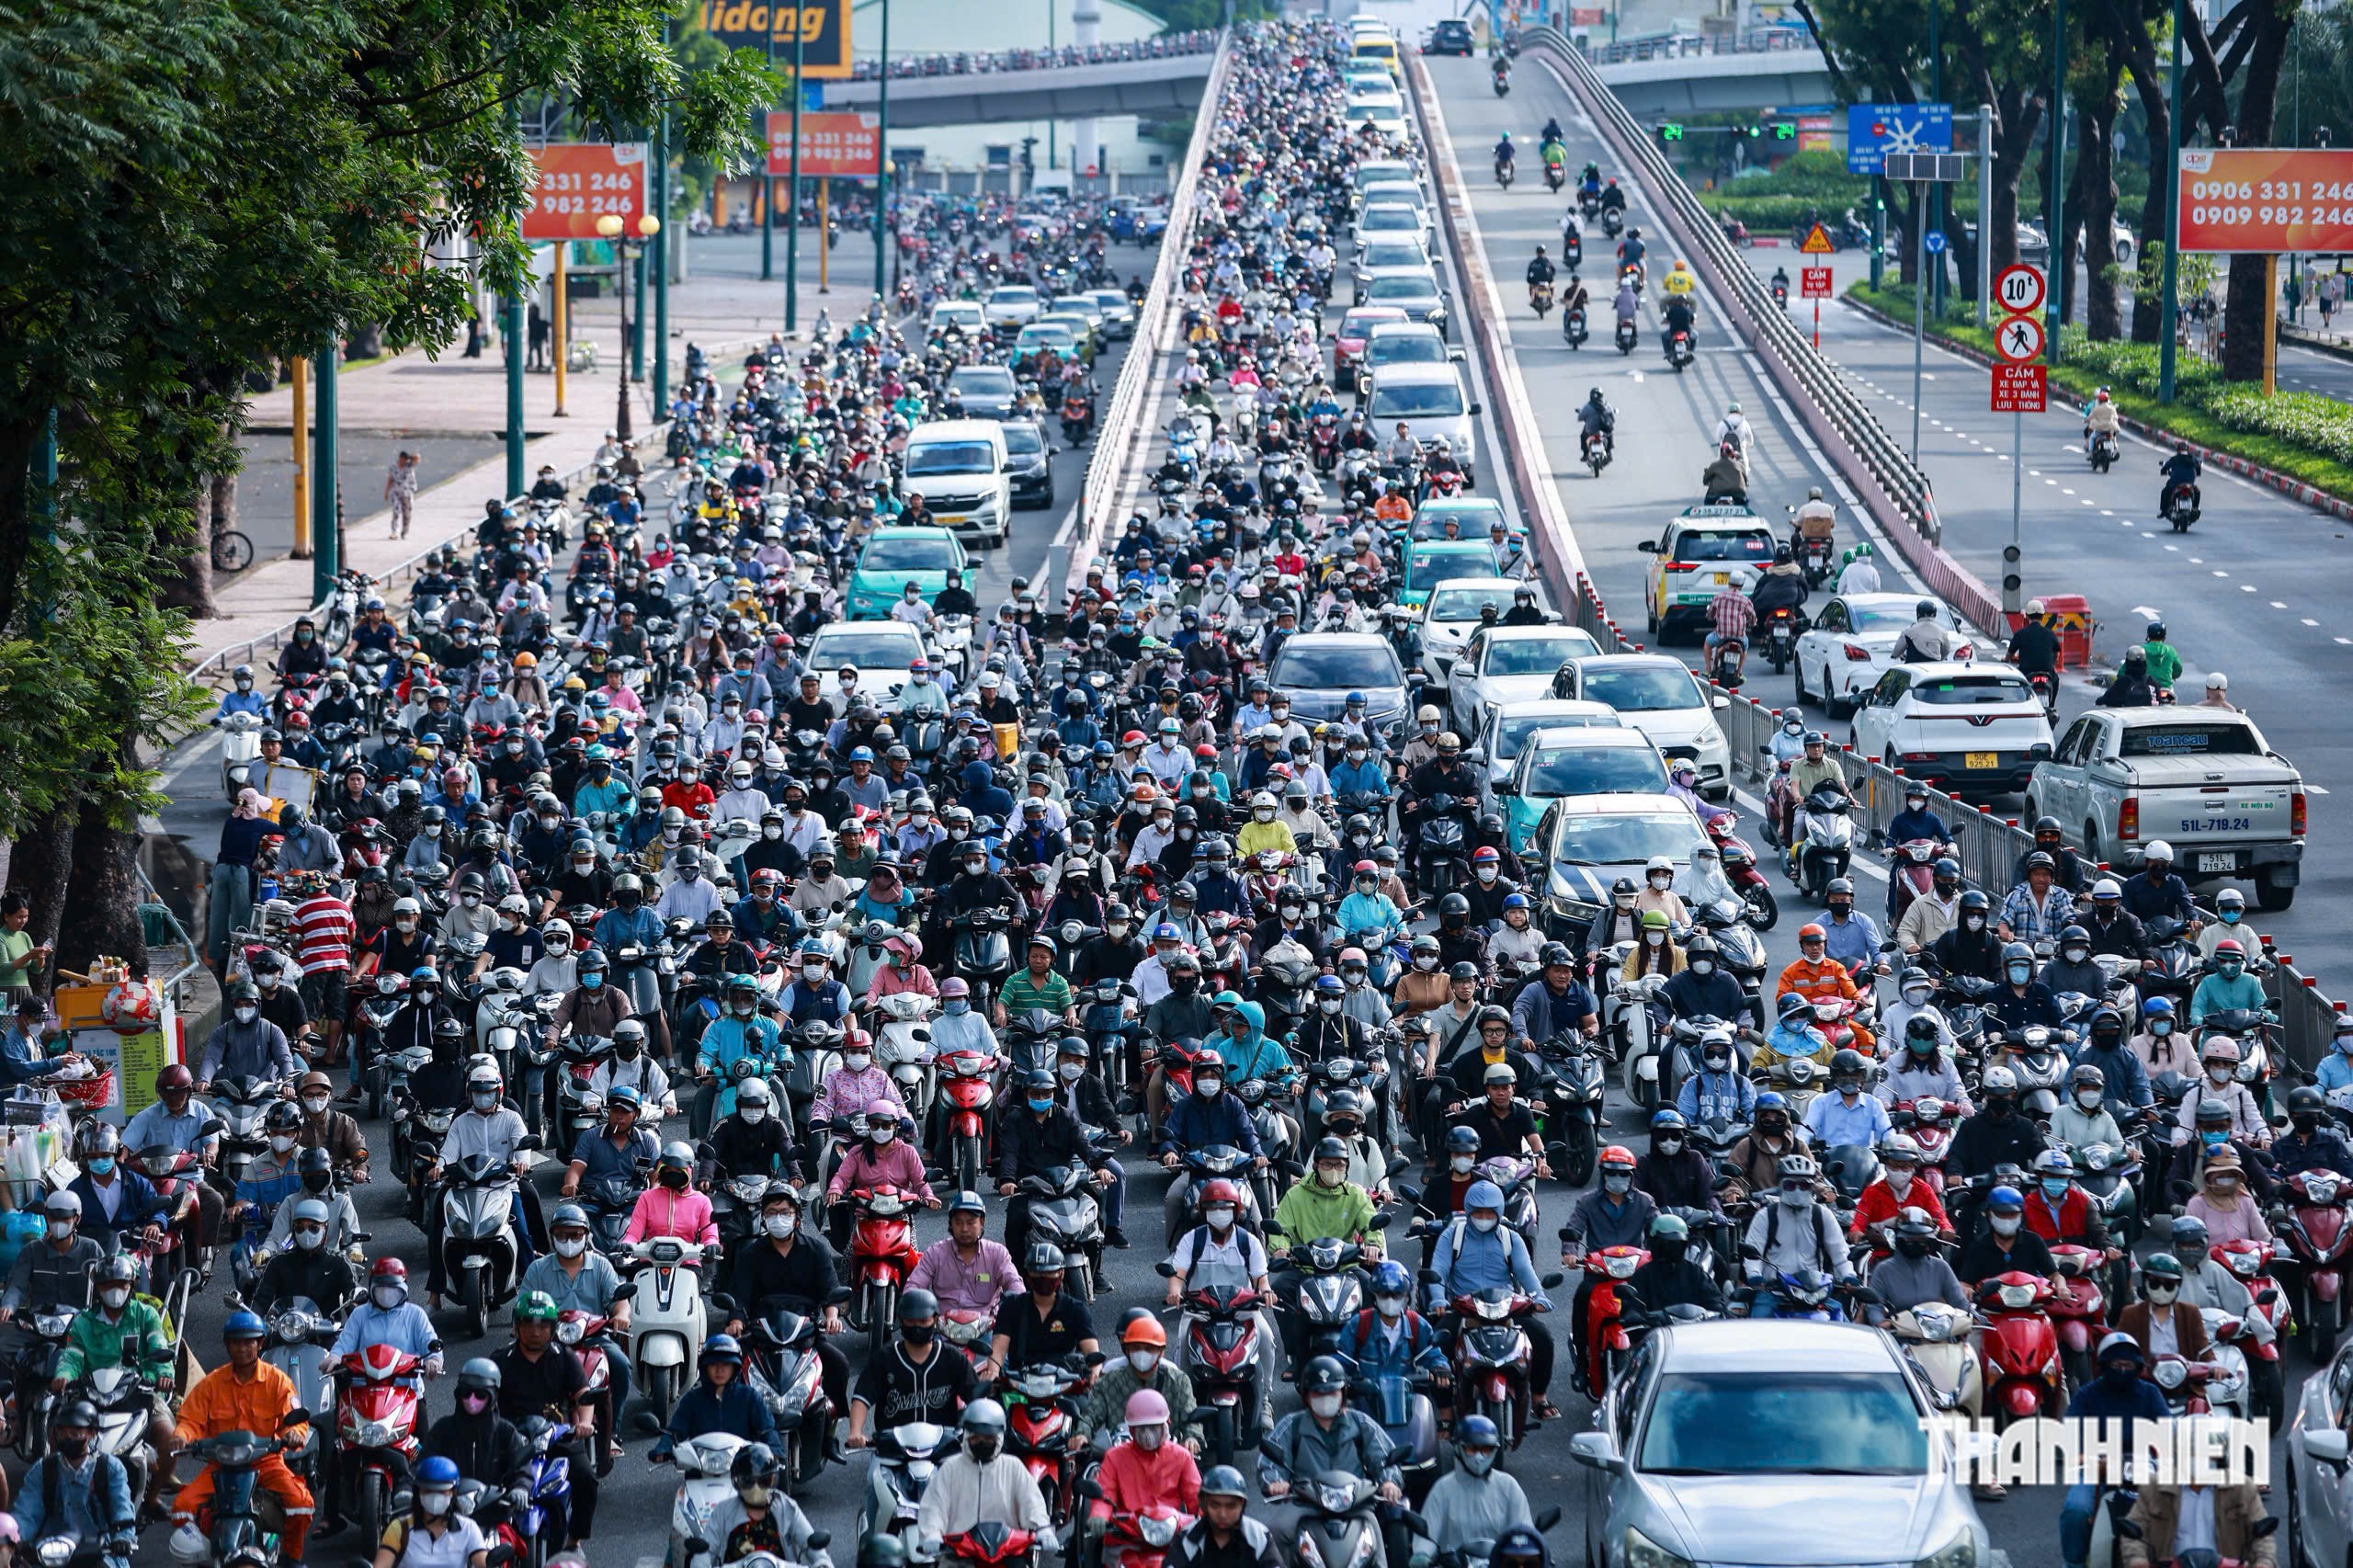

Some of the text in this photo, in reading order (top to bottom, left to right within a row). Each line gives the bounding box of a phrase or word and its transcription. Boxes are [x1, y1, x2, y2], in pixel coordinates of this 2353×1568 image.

[543, 173, 632, 191] 331 246
[2192, 181, 2253, 200] 0906
[2259, 181, 2302, 200] 331
[542, 196, 585, 214] 982
[591, 196, 632, 213] 246
[2192, 206, 2253, 225] 0909
[2259, 206, 2304, 225] 982
[1999, 380, 2008, 388] XE
[1998, 390, 2008, 398] XE
[2013, 391, 2018, 399] 3
[2251, 801, 2263, 810] NỘI
[2181, 818, 2249, 832] 51L-719.24
[2210, 854, 2225, 862] 51L
[2203, 862, 2232, 870] 719.24
[529, 1307, 545, 1315] Grab
